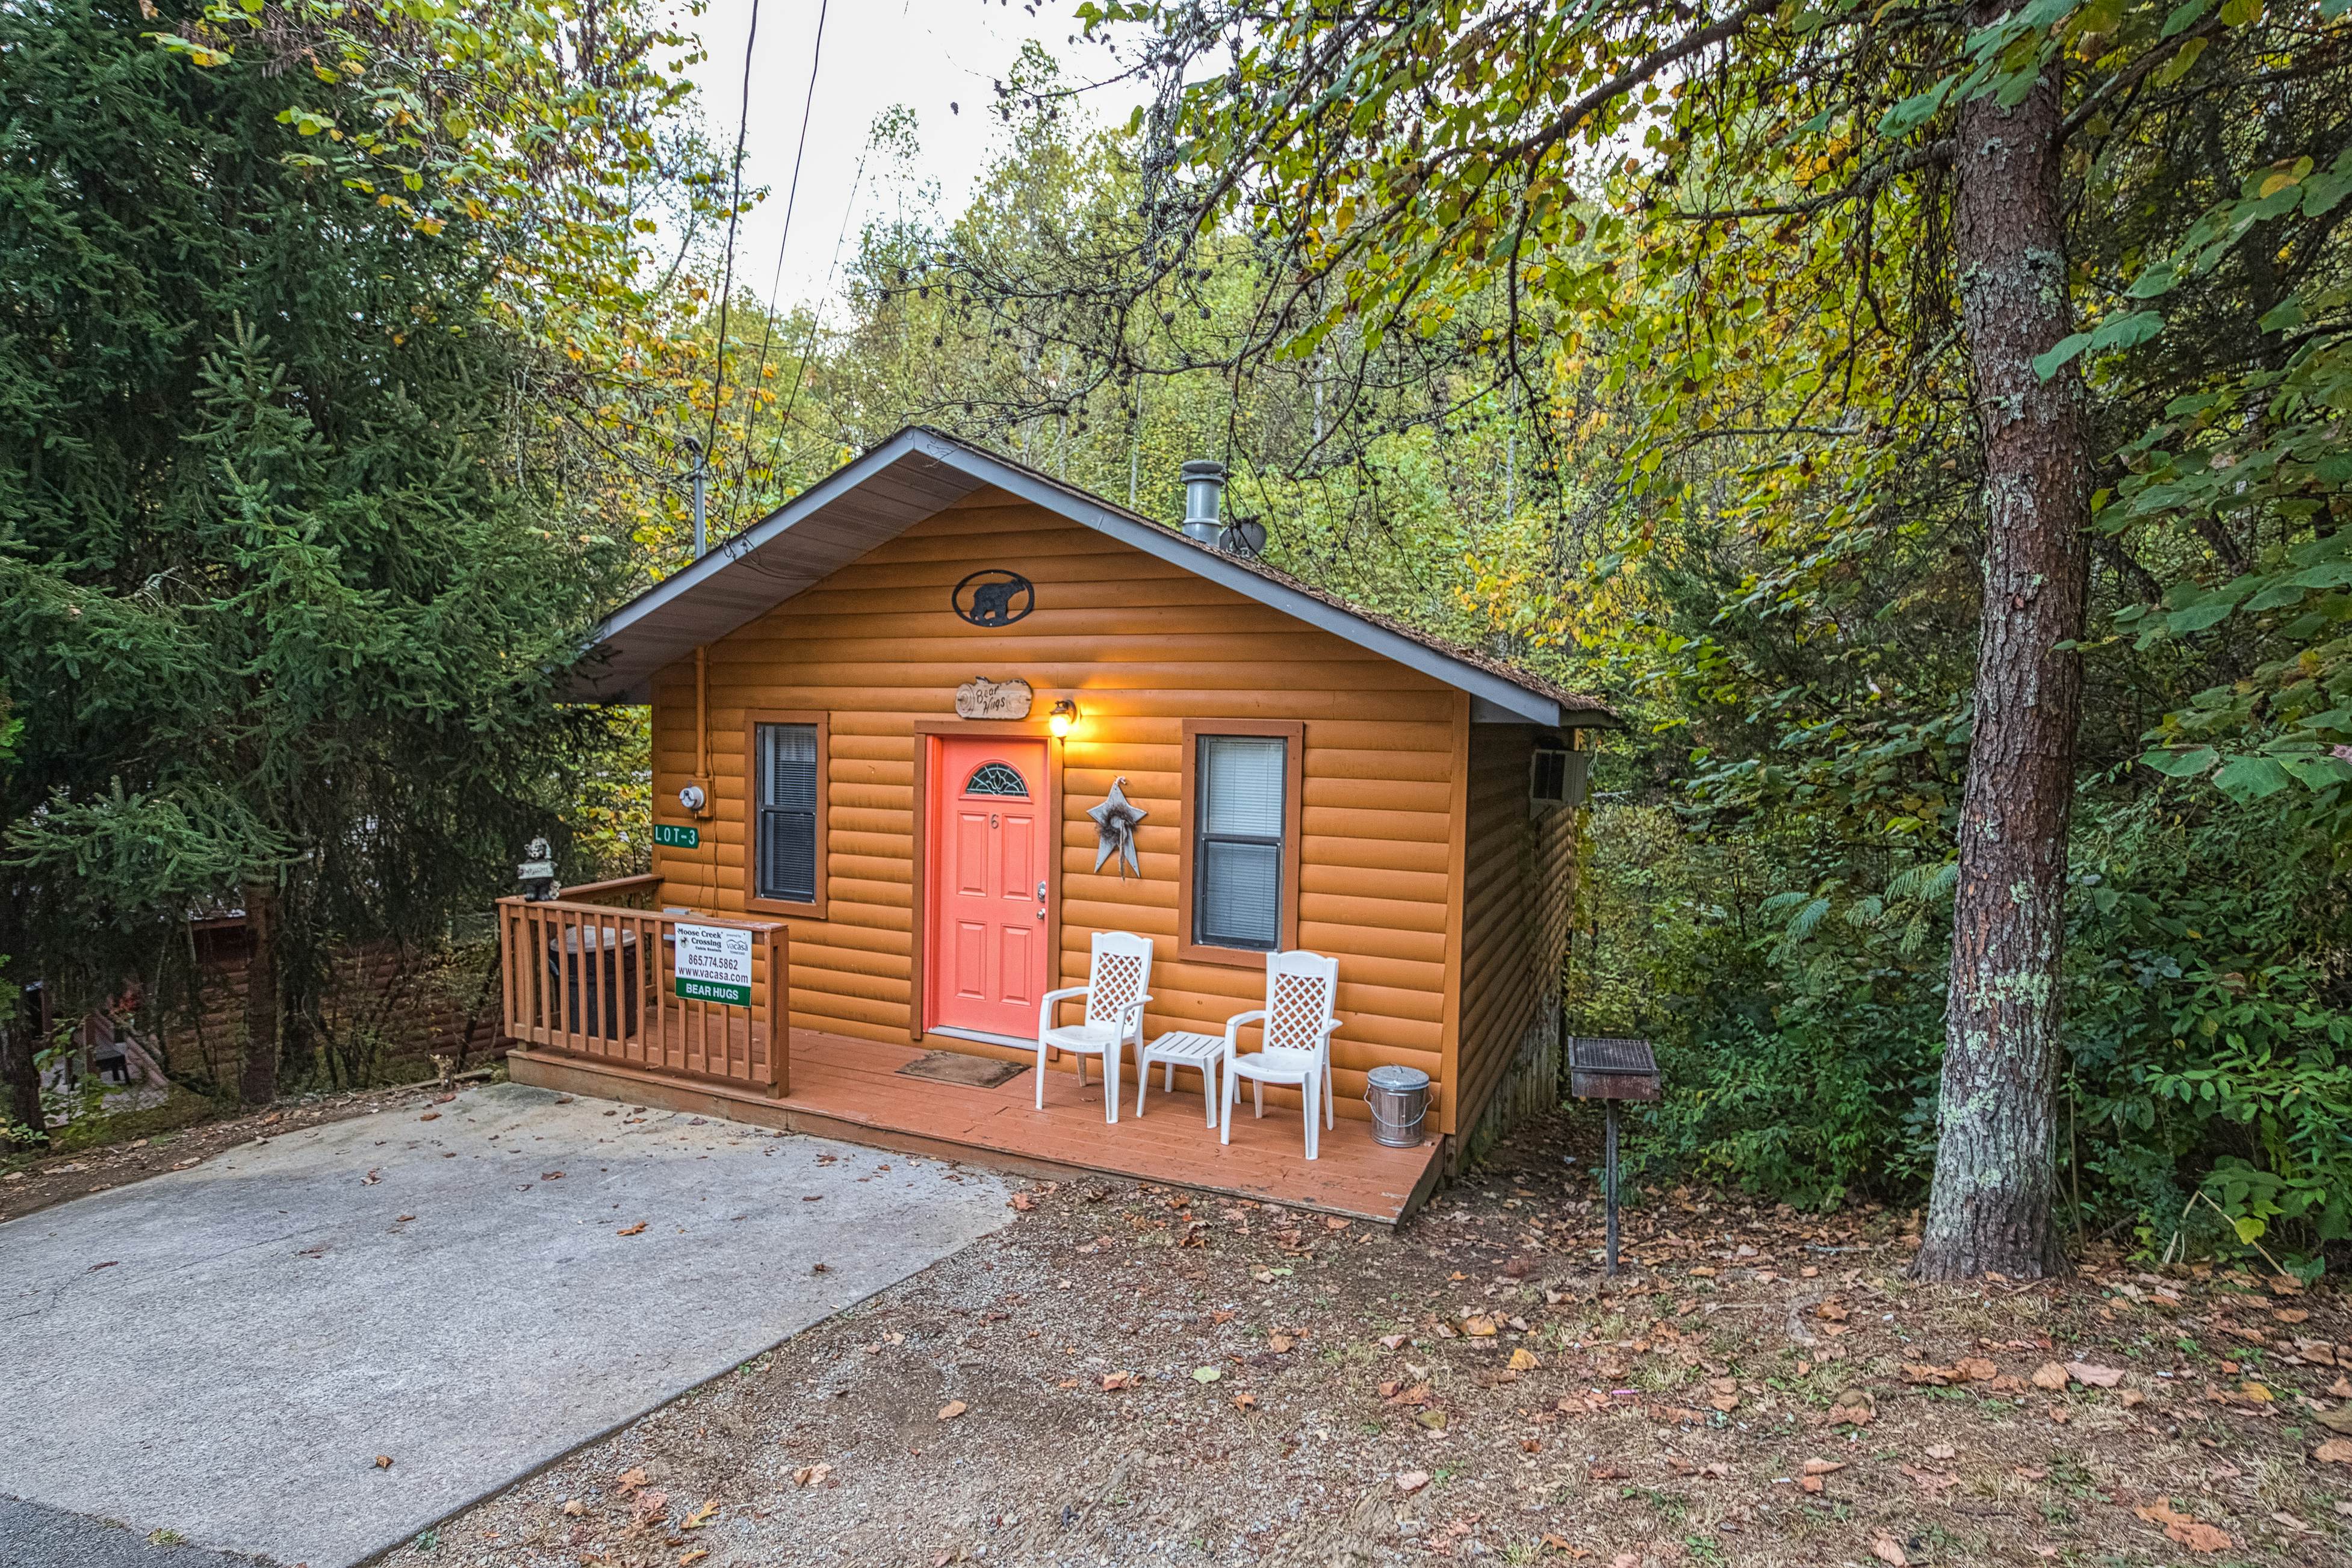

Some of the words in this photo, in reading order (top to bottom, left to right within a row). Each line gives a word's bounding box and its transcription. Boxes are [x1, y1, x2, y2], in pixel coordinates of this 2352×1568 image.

[976, 686, 999, 704] Bear
[982, 696, 1005, 715] Hugs
[991, 813, 999, 829] 6
[655, 825, 695, 845] LOT-3
[677, 928, 700, 937] Moose
[701, 931, 722, 939] Creek
[691, 937, 722, 949] Crossing
[688, 954, 738, 970] 865.774.5862
[678, 967, 748, 984] www.vacasa.com
[686, 982, 712, 997] BEAR
[713, 987, 739, 1000] HUGS
